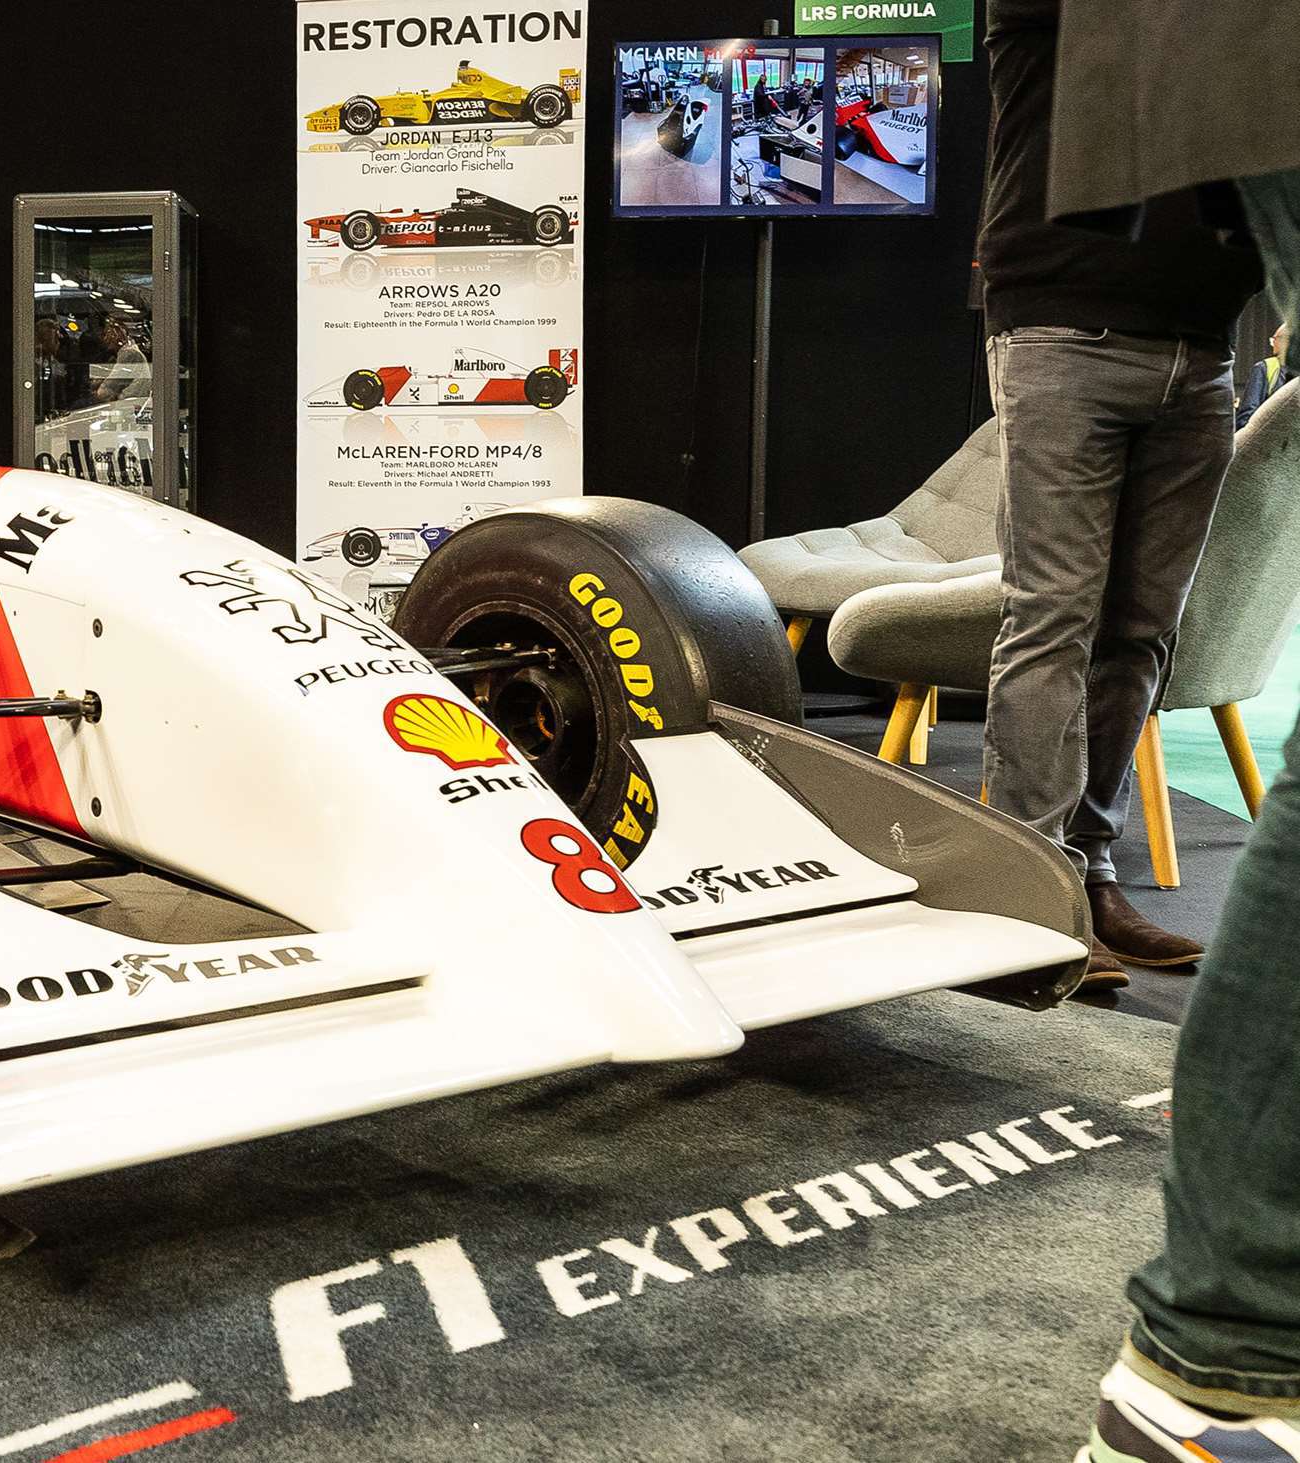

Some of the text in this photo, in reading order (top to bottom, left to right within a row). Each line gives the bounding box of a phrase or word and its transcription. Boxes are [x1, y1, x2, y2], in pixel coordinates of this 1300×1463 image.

[801, 2, 937, 21] LRS FORMULA
[303, 10, 582, 52] RESTORATION
[619, 46, 698, 62] MCLAREN
[880, 120, 924, 134] PEUGEOT
[380, 128, 493, 146] JORDAN EJ13
[446, 147, 483, 160] Grand
[486, 146, 506, 158] Prix
[361, 159, 514, 175] Driver: Giancarlo Fisichella
[384, 223, 433, 234] REPSOL
[438, 224, 492, 233] t-minus
[378, 283, 501, 299] ARROWS A20
[389, 299, 491, 309] Team: REPSOL ARROWS
[383, 311, 414, 319] Drivers:
[416, 310, 441, 318] Pedro
[443, 310, 455, 318] DE
[471, 309, 496, 317] ROSA
[324, 321, 351, 329] Result:
[353, 320, 398, 330] Eighteenth
[409, 320, 422, 328] the
[424, 319, 458, 327] Formula
[466, 319, 491, 327] World
[493, 318, 535, 328] Champion
[537, 318, 557, 326] 1999
[453, 359, 506, 371] Marlboro
[337, 443, 543, 460] McLAREN-FORD MP4/8
[405, 461, 455, 469] MARLBORO
[457, 460, 498, 468] McLAREN
[384, 470, 494, 478] Drivers: Michael ANDRETTI
[328, 480, 355, 488] Result:
[357, 480, 393, 488] Eleventh
[394, 480, 402, 488] in
[404, 480, 417, 488] the
[419, 480, 453, 488] Formula
[460, 480, 486, 488] World
[487, 480, 530, 489] Champion
[531, 480, 552, 488] 1993
[294, 659, 434, 697] PEUGEO
[439, 773, 549, 804] Shel
[521, 818, 643, 914] 8
[269, 1105, 1123, 1402] F1 EXPERIENCE
